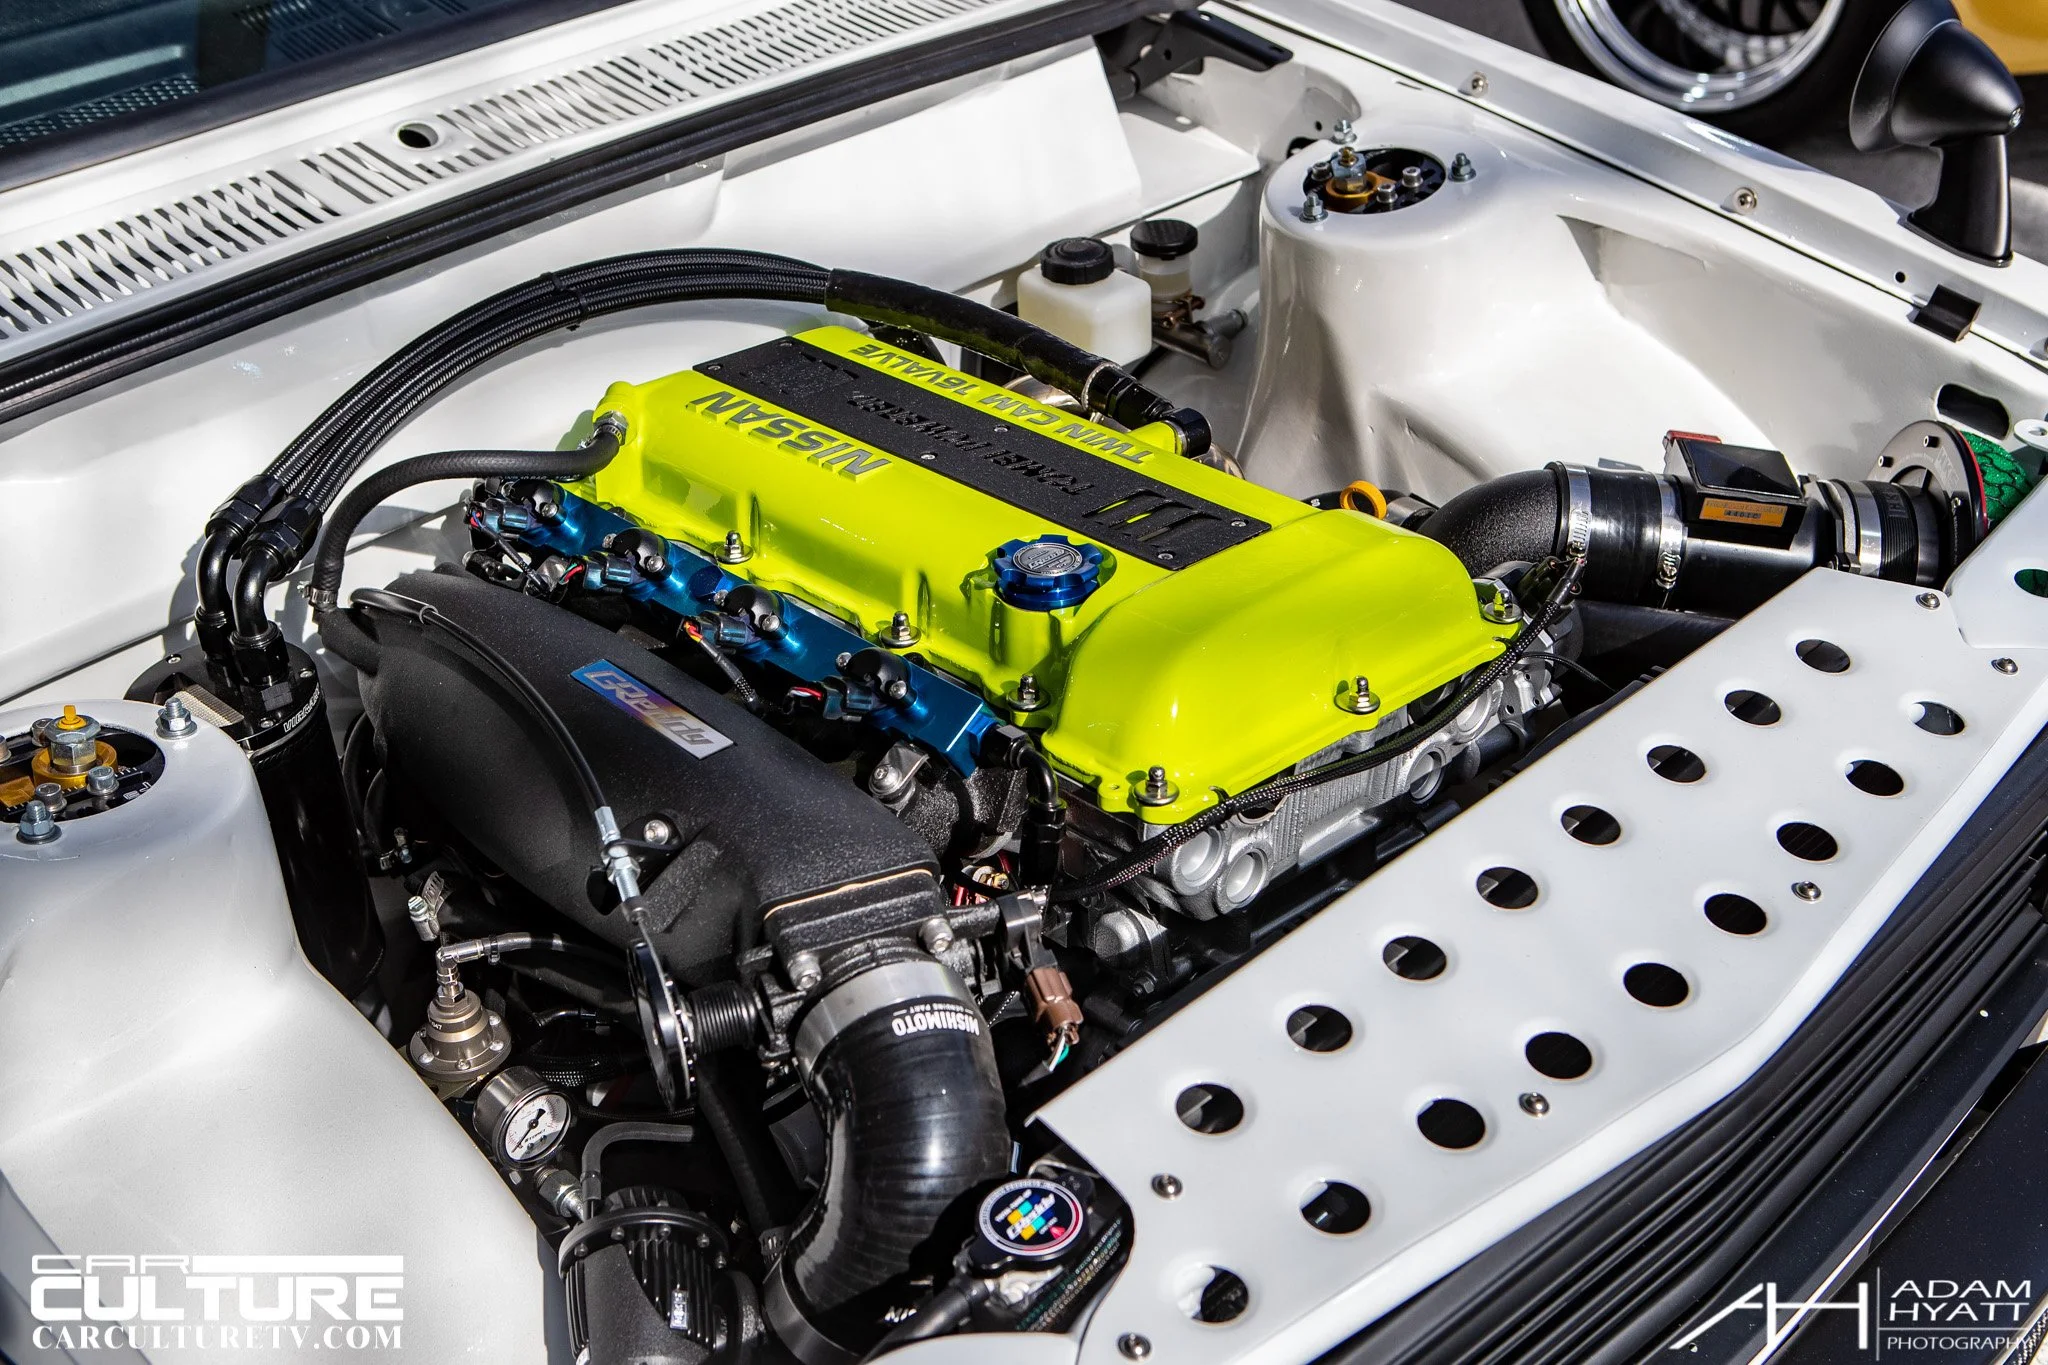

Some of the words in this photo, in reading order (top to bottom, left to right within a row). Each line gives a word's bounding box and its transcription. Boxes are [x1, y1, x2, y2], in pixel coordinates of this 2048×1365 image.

[848, 343, 980, 396] 16VALVE
[981, 393, 1061, 426] CAM
[688, 390, 892, 479] NISSAN
[1056, 421, 1155, 465] TWIN
[891, 1010, 980, 1037] MISHIMOTO
[909, 1003, 931, 1014] PART
